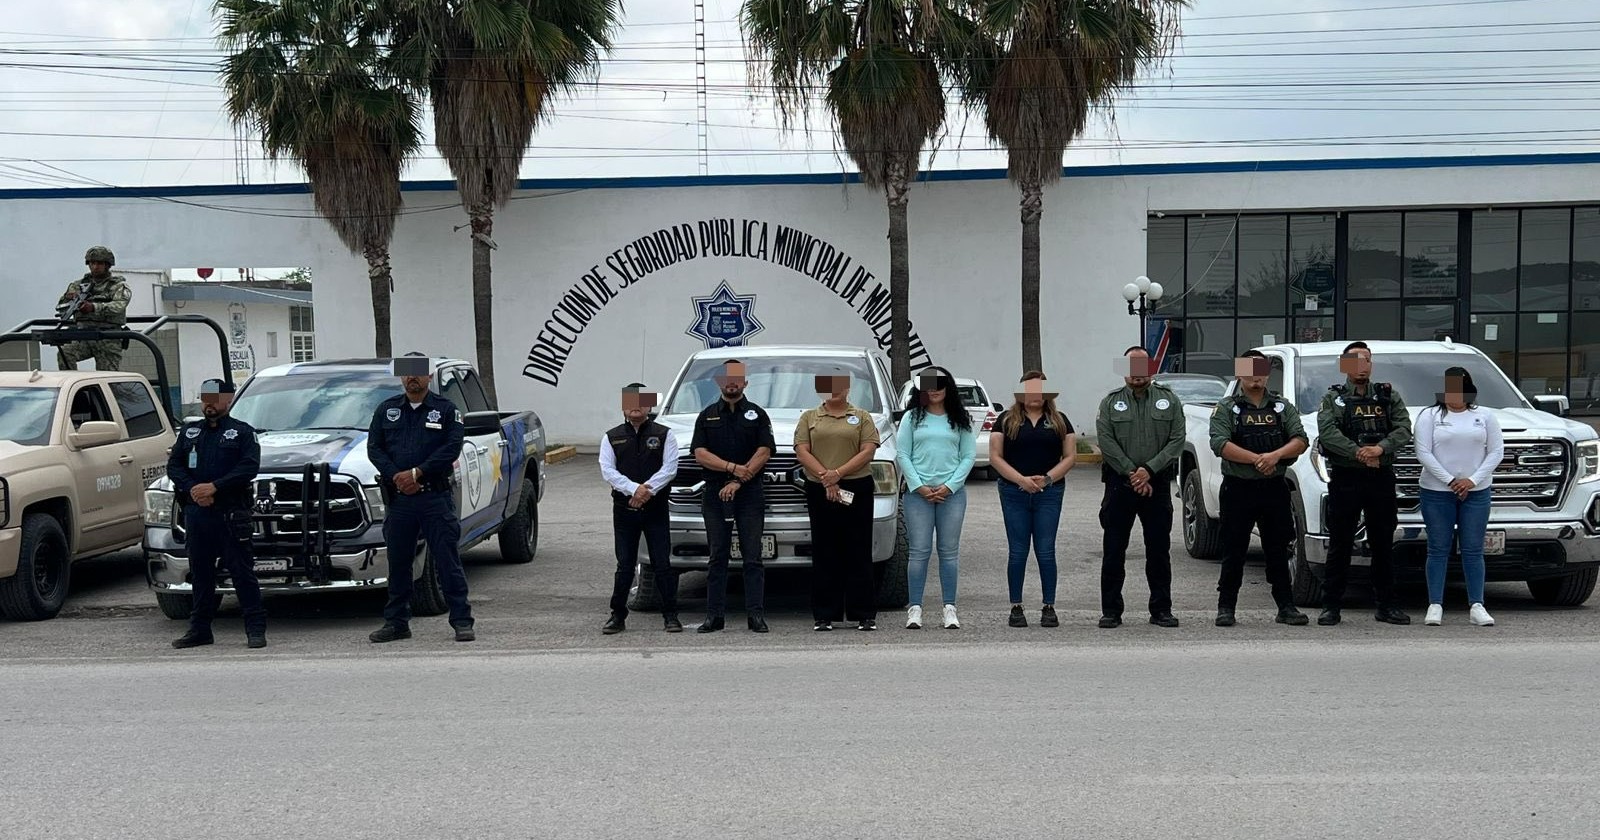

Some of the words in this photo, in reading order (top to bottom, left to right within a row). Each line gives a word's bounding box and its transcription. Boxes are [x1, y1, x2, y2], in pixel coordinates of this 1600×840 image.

[581, 265, 618, 306] DE
[605, 223, 697, 289] SEGURIDAD
[698, 217, 768, 261] PÚBLICA
[771, 224, 852, 294] MUNICIPAL
[839, 265, 875, 307] DE
